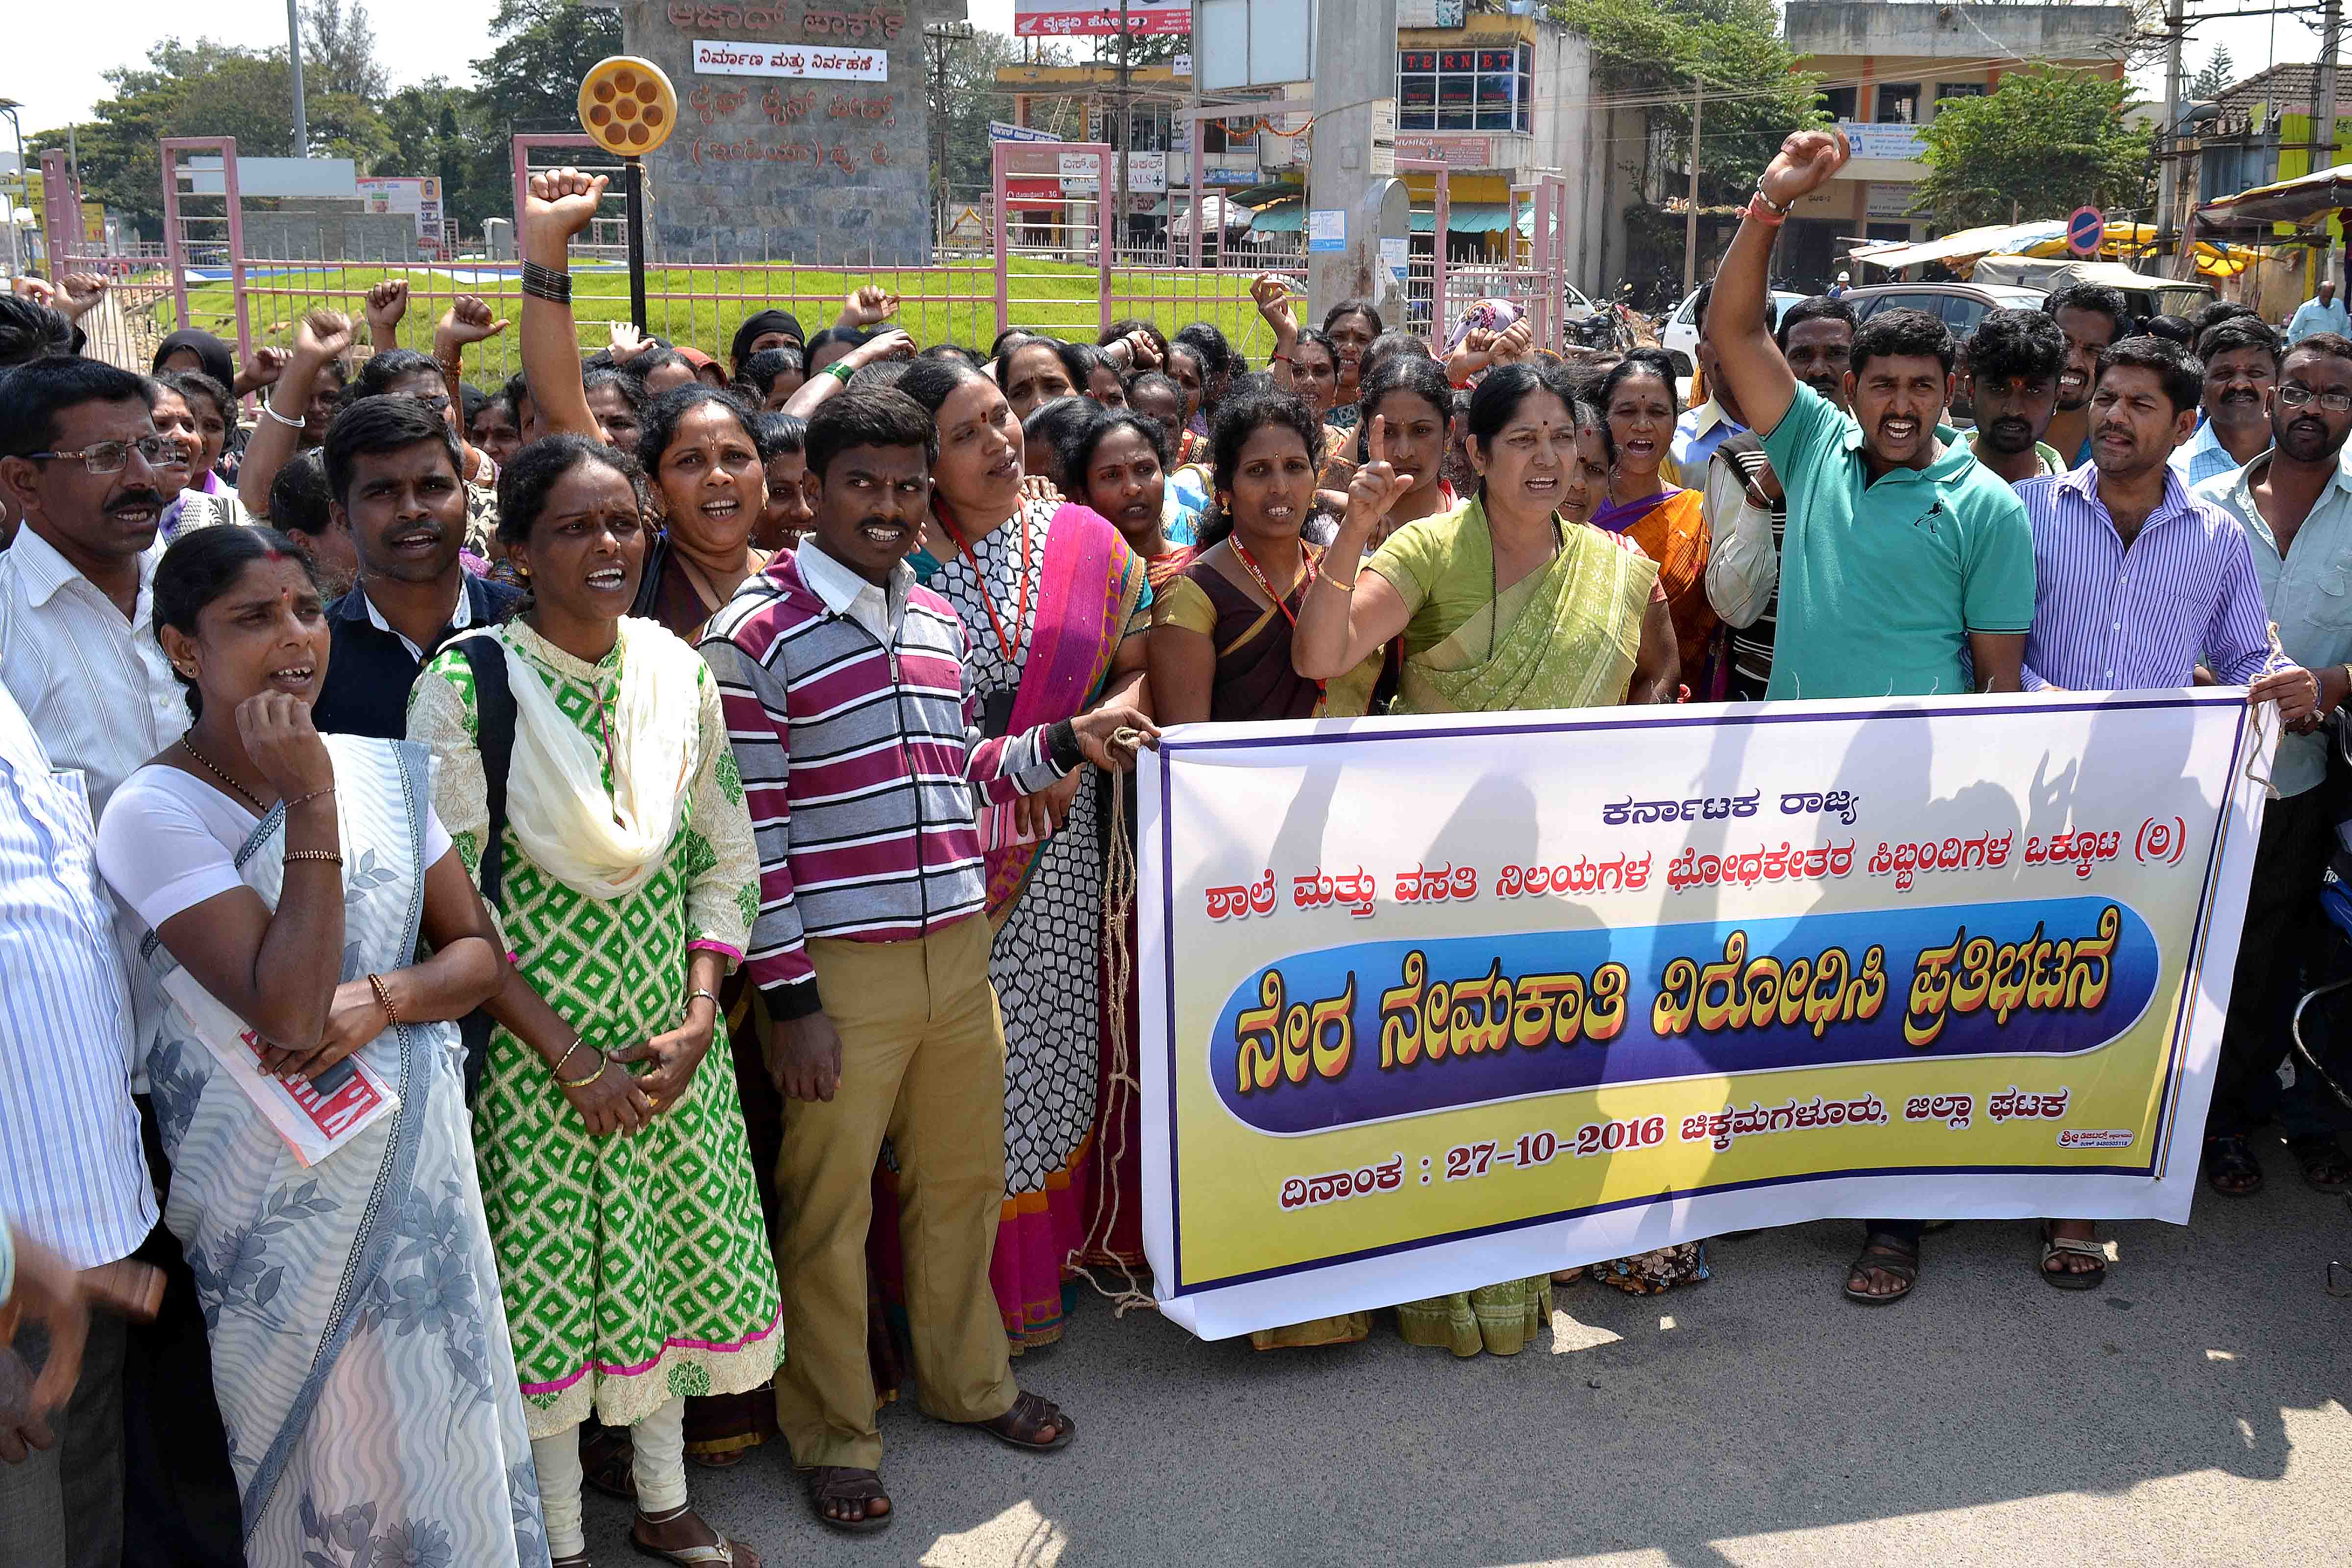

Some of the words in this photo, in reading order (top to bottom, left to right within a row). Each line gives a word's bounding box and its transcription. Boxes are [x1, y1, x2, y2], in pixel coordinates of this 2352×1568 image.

[699, 49, 763, 65] ನಿರ್ಮಾಣ
[771, 52, 805, 74] ಮತ್ತು
[811, 54, 873, 71] ನಿರ್ವಹಣೆ
[1603, 787, 1759, 825] ಕರ್ನಾಟಕ
[1781, 789, 1859, 825] ರಾಜ್ಯ
[1204, 868, 1277, 920] ಶಾಲೆ
[1293, 864, 1377, 915] ಮತ್ತು
[1395, 860, 1478, 902] ವಸತಿ
[1496, 851, 1653, 896] ನಿಲಯಗಳ
[1667, 837, 1856, 891] ಭೋಧಕೇತರ
[1868, 828, 2012, 890] ಸಿಬ್ಬಂದಿಗಳ
[2025, 825, 2120, 877] ಒಕ್ಕೂಟ
[2135, 816, 2186, 863] (ರಿ)
[1236, 969, 1355, 1092] ನೇರ
[1379, 950, 1630, 1069] ನೇಮಕಾತಿ
[1651, 930, 1886, 1038] ವಿರೋಧಿಸಿ
[1903, 905, 2121, 1047] ಪ್ರತಿಭಟನೆ
[1281, 1154, 1402, 1209] ದಿನಾಂಕ
[1446, 1117, 1665, 1178] 27-10-2016
[1681, 1094, 1888, 1149] ಚಿಕ್ಕಮಗಳೂರು,
[1905, 1094, 1973, 1128] ಜಿಲ್ಲಾ
[1988, 1087, 2069, 1123] ಘಟಕ
[2059, 1130, 2079, 1146] ಶ್ರೀ
